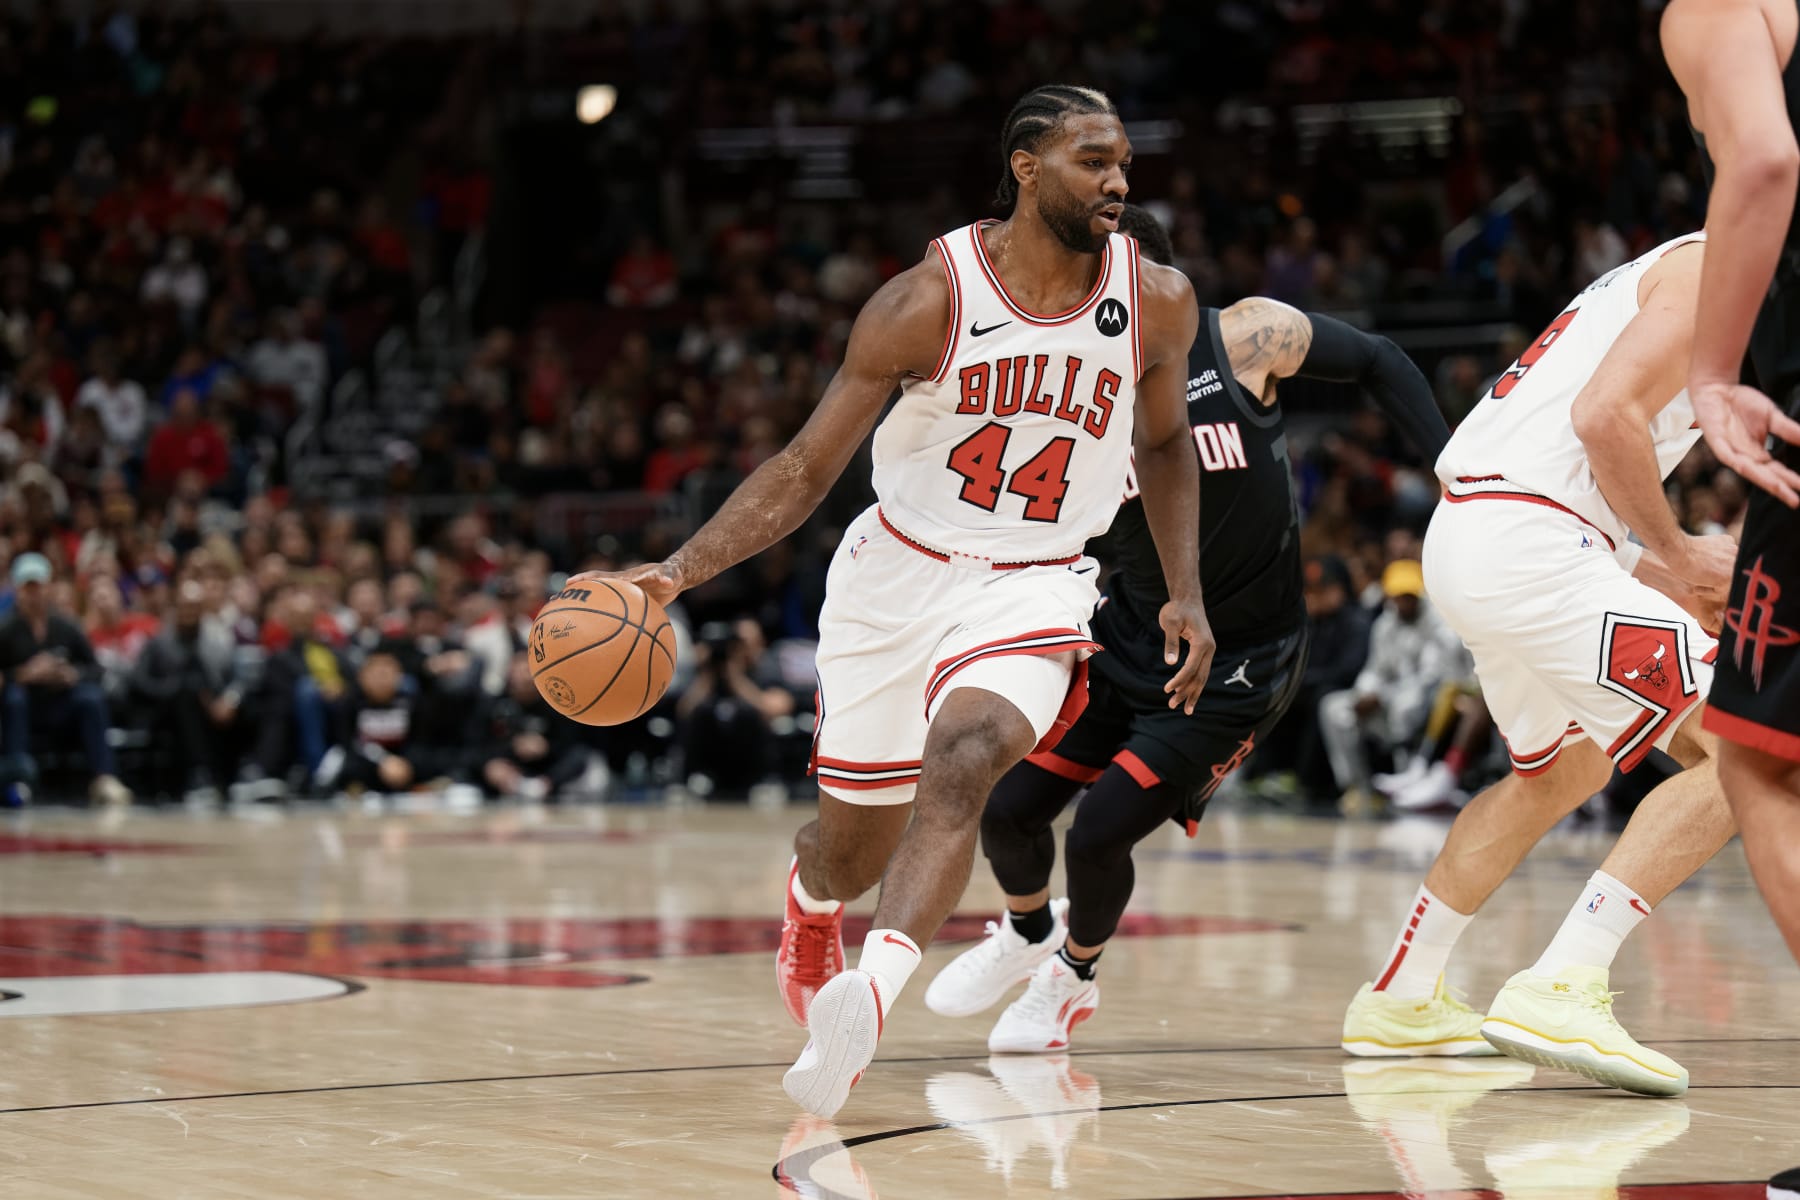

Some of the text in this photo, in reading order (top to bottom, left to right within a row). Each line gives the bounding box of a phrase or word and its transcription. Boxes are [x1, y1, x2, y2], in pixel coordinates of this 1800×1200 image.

[955, 354, 1122, 440] BULLS
[1186, 369, 1218, 391] redit
[946, 421, 1076, 523] 44
